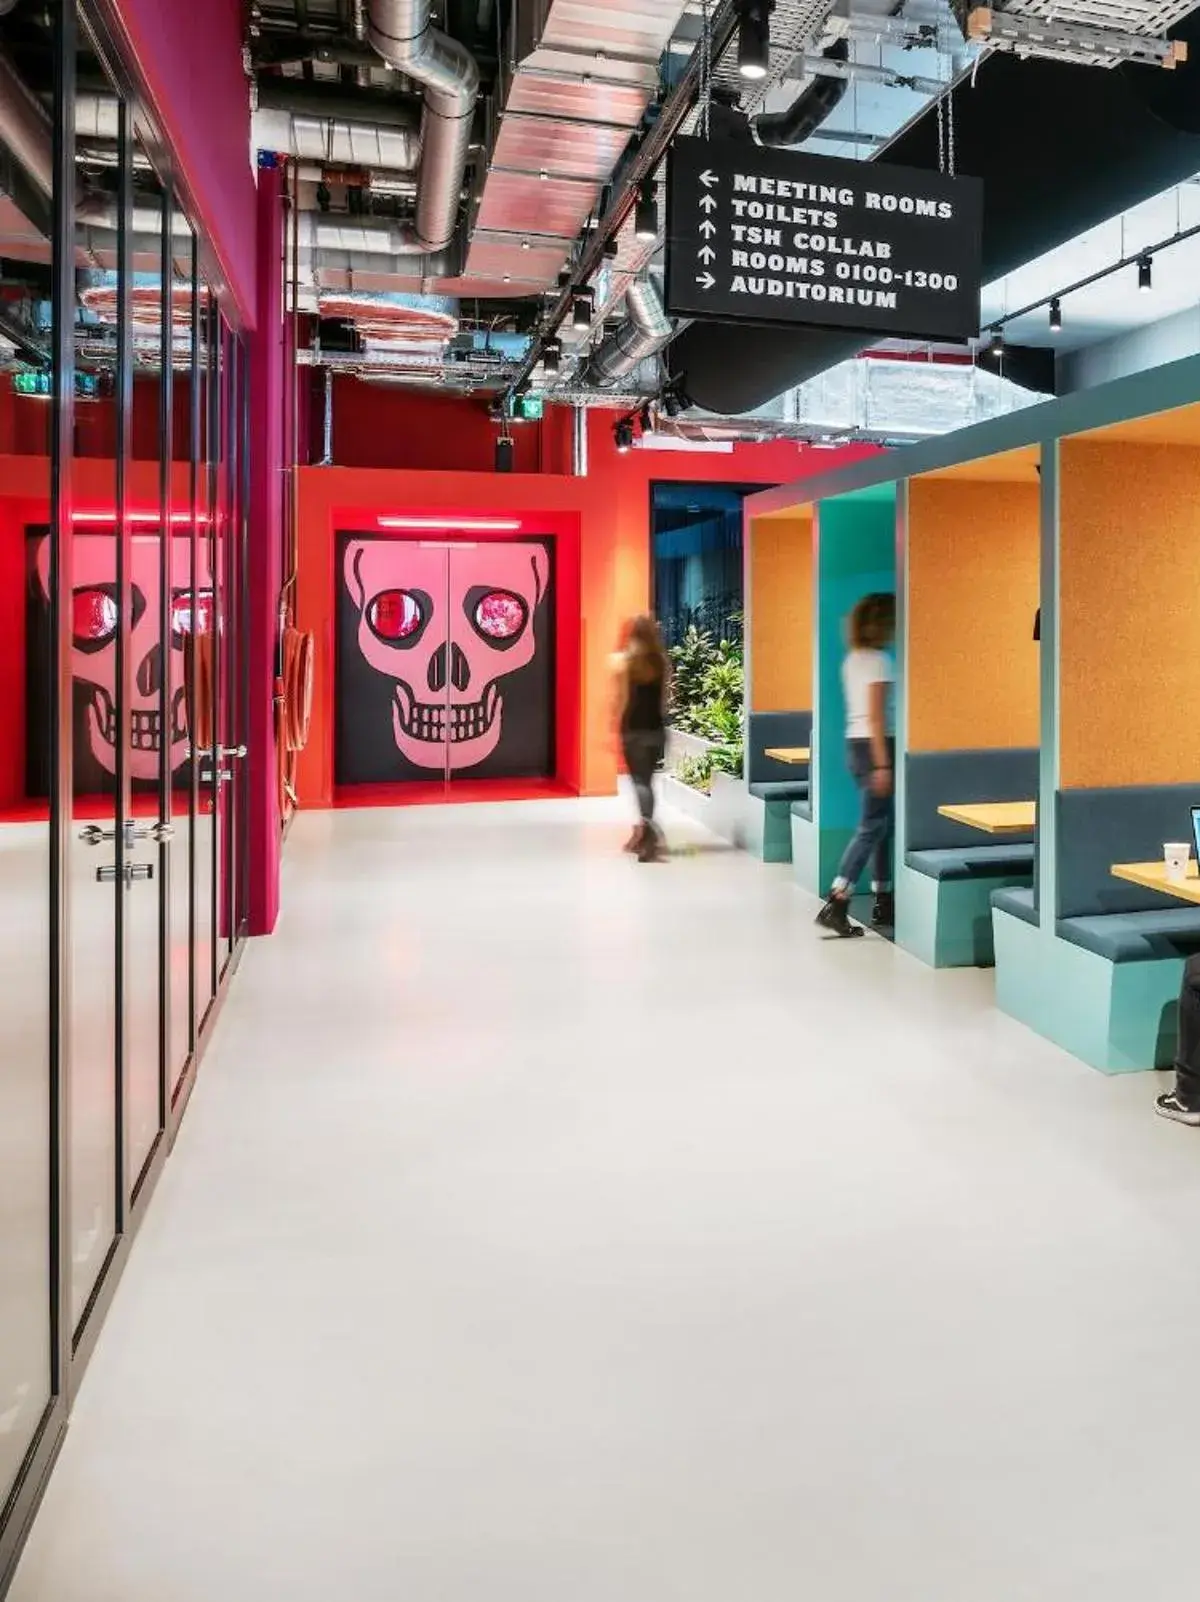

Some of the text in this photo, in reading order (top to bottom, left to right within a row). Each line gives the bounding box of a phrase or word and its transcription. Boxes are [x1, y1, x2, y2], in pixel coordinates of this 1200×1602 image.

[731, 199, 838, 229] TOILETS
[733, 174, 953, 219] MEETING ROOMS
[730, 224, 892, 259] TSH COLLAB
[731, 248, 958, 292] ROOMS 0100-1300
[730, 275, 897, 309] AUDITORIUM
